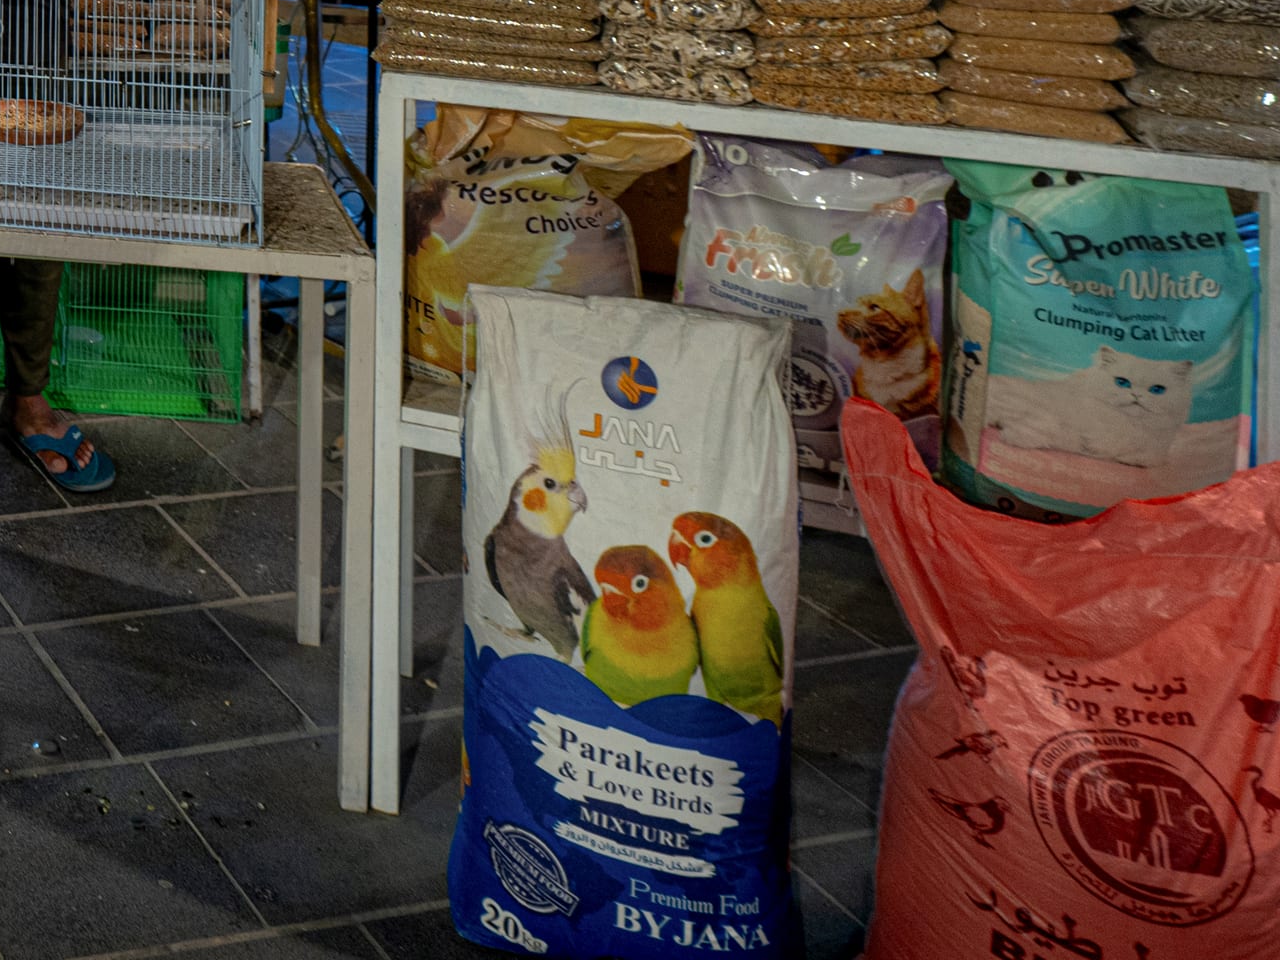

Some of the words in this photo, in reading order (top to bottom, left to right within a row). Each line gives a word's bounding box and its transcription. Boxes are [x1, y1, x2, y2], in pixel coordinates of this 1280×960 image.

[525, 212, 604, 235] Choice"
[1050, 228, 1227, 263] Promaster
[1024, 254, 1116, 298] Super
[1119, 266, 1222, 300] White
[1034, 306, 1125, 341] Clumping
[1130, 324, 1159, 340] Cat
[1164, 325, 1207, 342] Litter
[579, 412, 682, 454] JANA
[1133, 676, 1189, 700] توب
[1113, 705, 1196, 728] green
[558, 726, 715, 788] Parakeets
[558, 760, 578, 782] &
[587, 769, 644, 802] Love
[651, 789, 714, 816] Birds
[579, 806, 691, 851] MIXTURE
[539, 875, 573, 904] FOOD
[629, 878, 715, 915] Premium
[719, 893, 761, 917] Food
[483, 903, 520, 940] 20
[614, 901, 672, 940] BY
[673, 919, 771, 953] JANA
